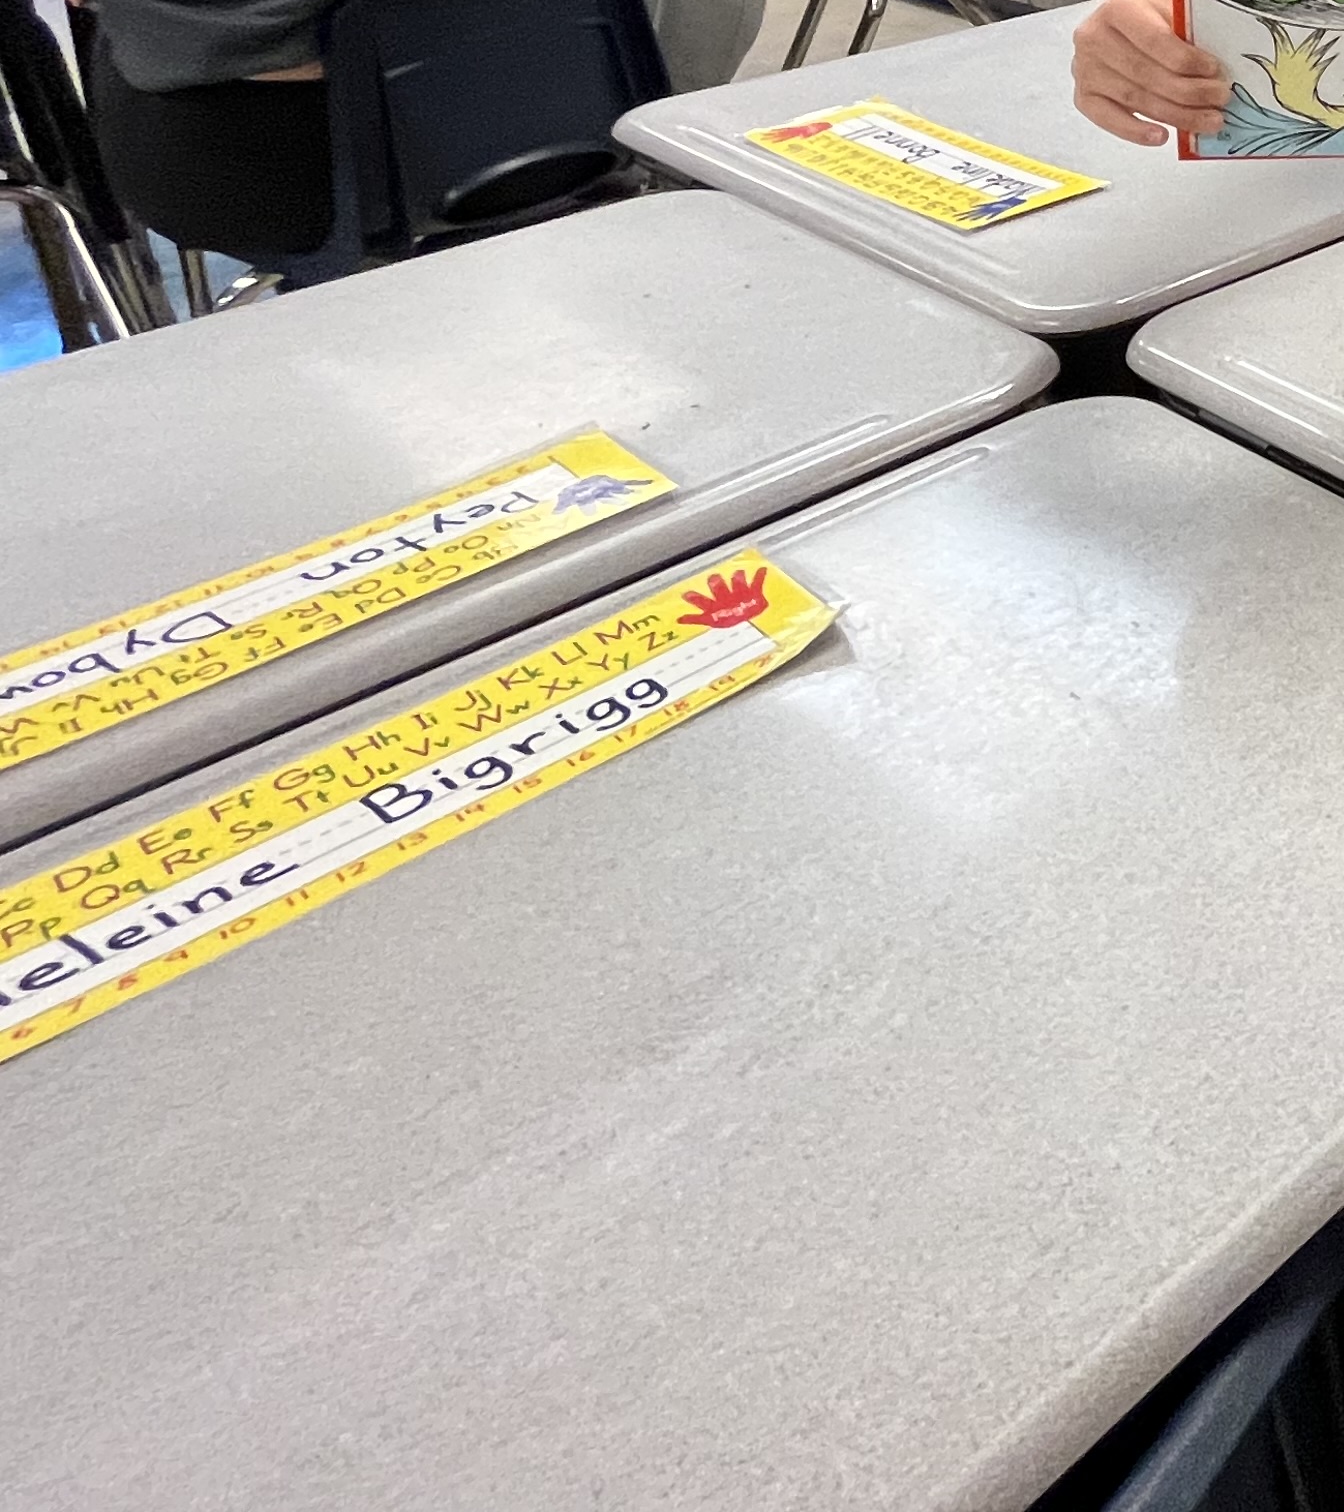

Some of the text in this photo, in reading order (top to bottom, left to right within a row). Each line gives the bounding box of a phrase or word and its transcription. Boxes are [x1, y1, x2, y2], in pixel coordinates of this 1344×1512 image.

[301, 490, 538, 580] Peyton
[0, 675, 668, 1006] eleine Bigrigg
